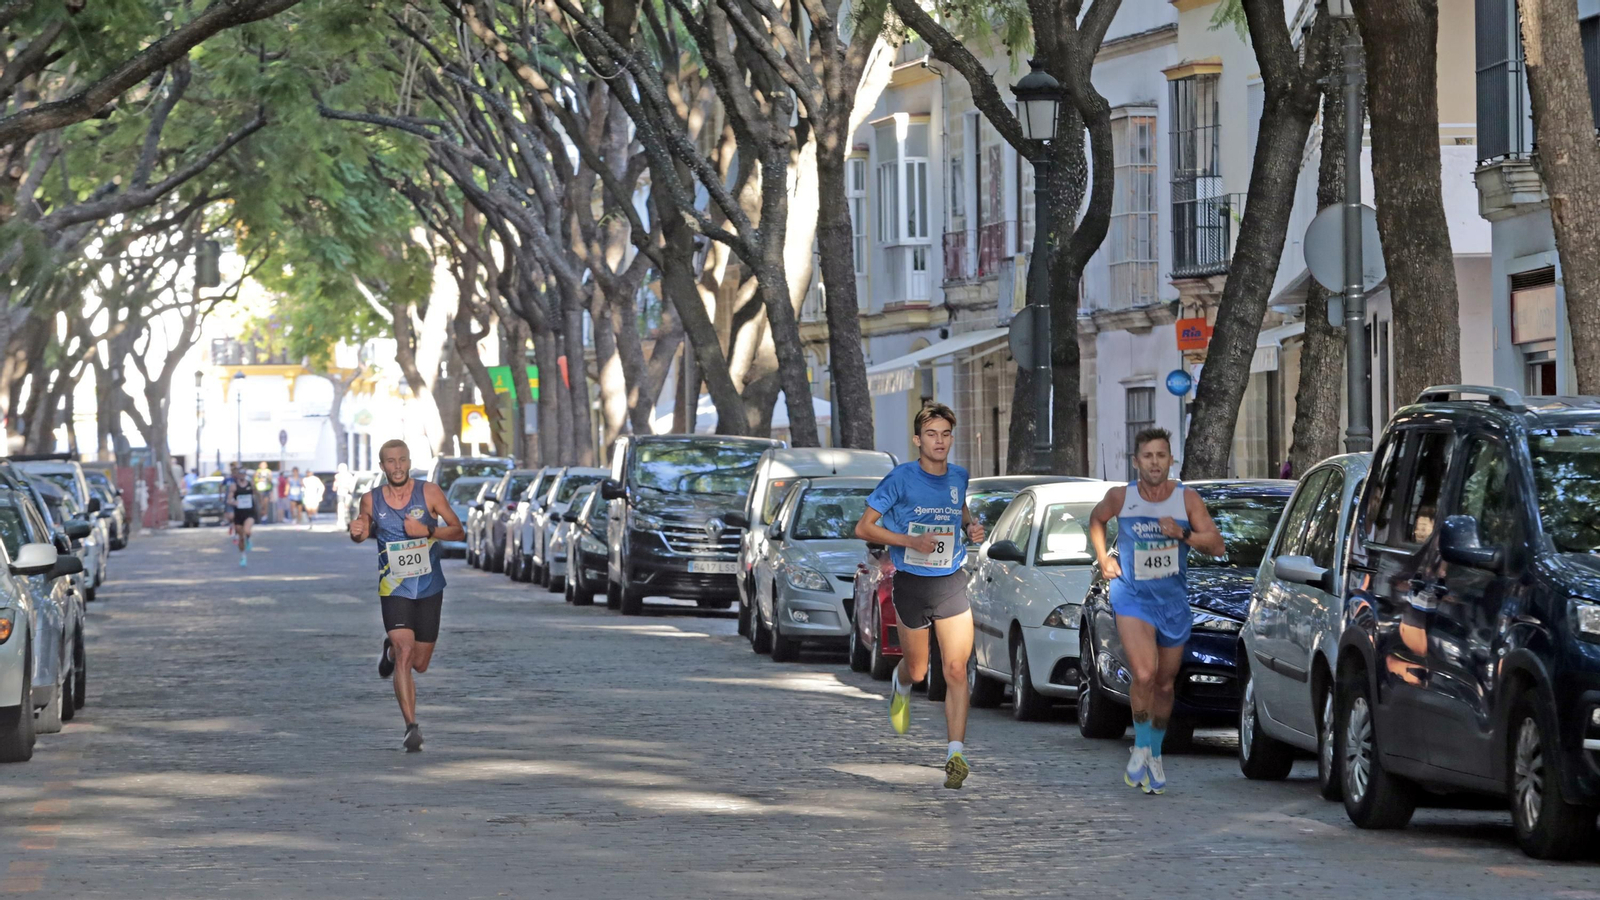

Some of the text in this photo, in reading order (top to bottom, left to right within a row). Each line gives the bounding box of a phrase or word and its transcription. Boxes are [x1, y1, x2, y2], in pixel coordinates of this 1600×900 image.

[1182, 326, 1201, 337] Ria
[398, 553, 422, 566] 820
[1144, 556, 1172, 568] 483
[694, 563, 736, 572] 6417 LSS
